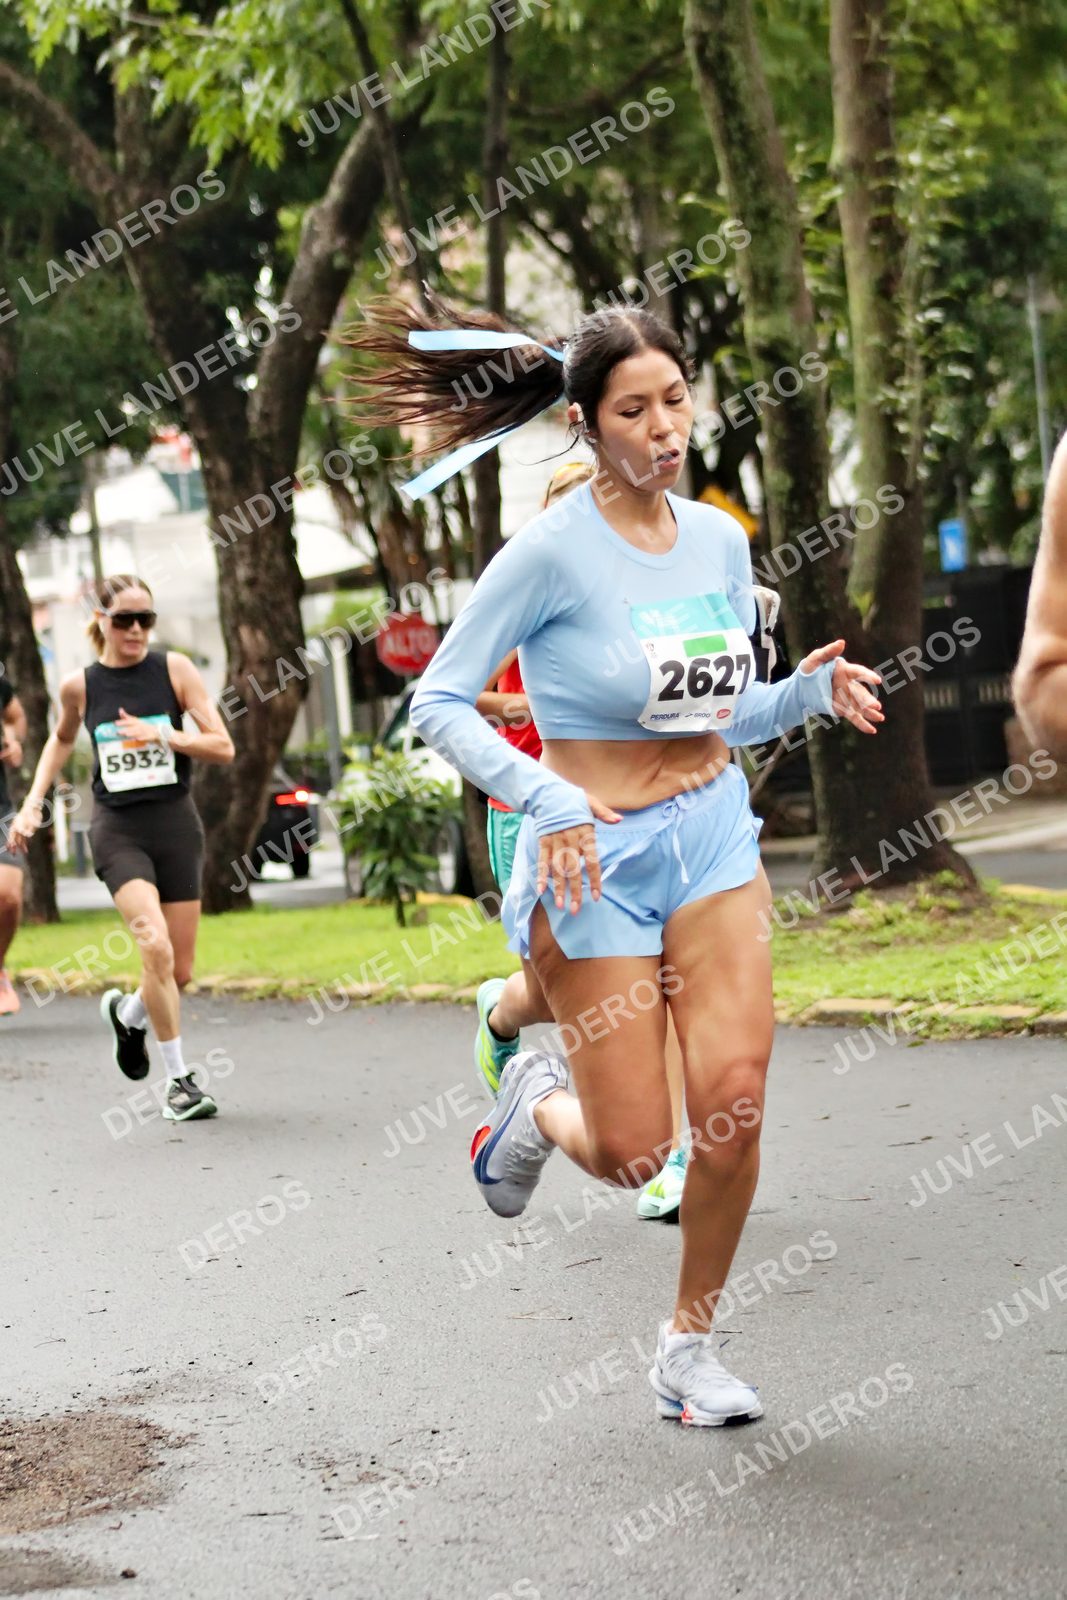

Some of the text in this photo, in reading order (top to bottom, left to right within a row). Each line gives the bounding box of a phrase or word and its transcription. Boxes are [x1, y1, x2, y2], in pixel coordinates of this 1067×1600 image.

[383, 628, 437, 658] ALTO
[658, 654, 751, 701] 2627
[106, 748, 169, 773] 5932
